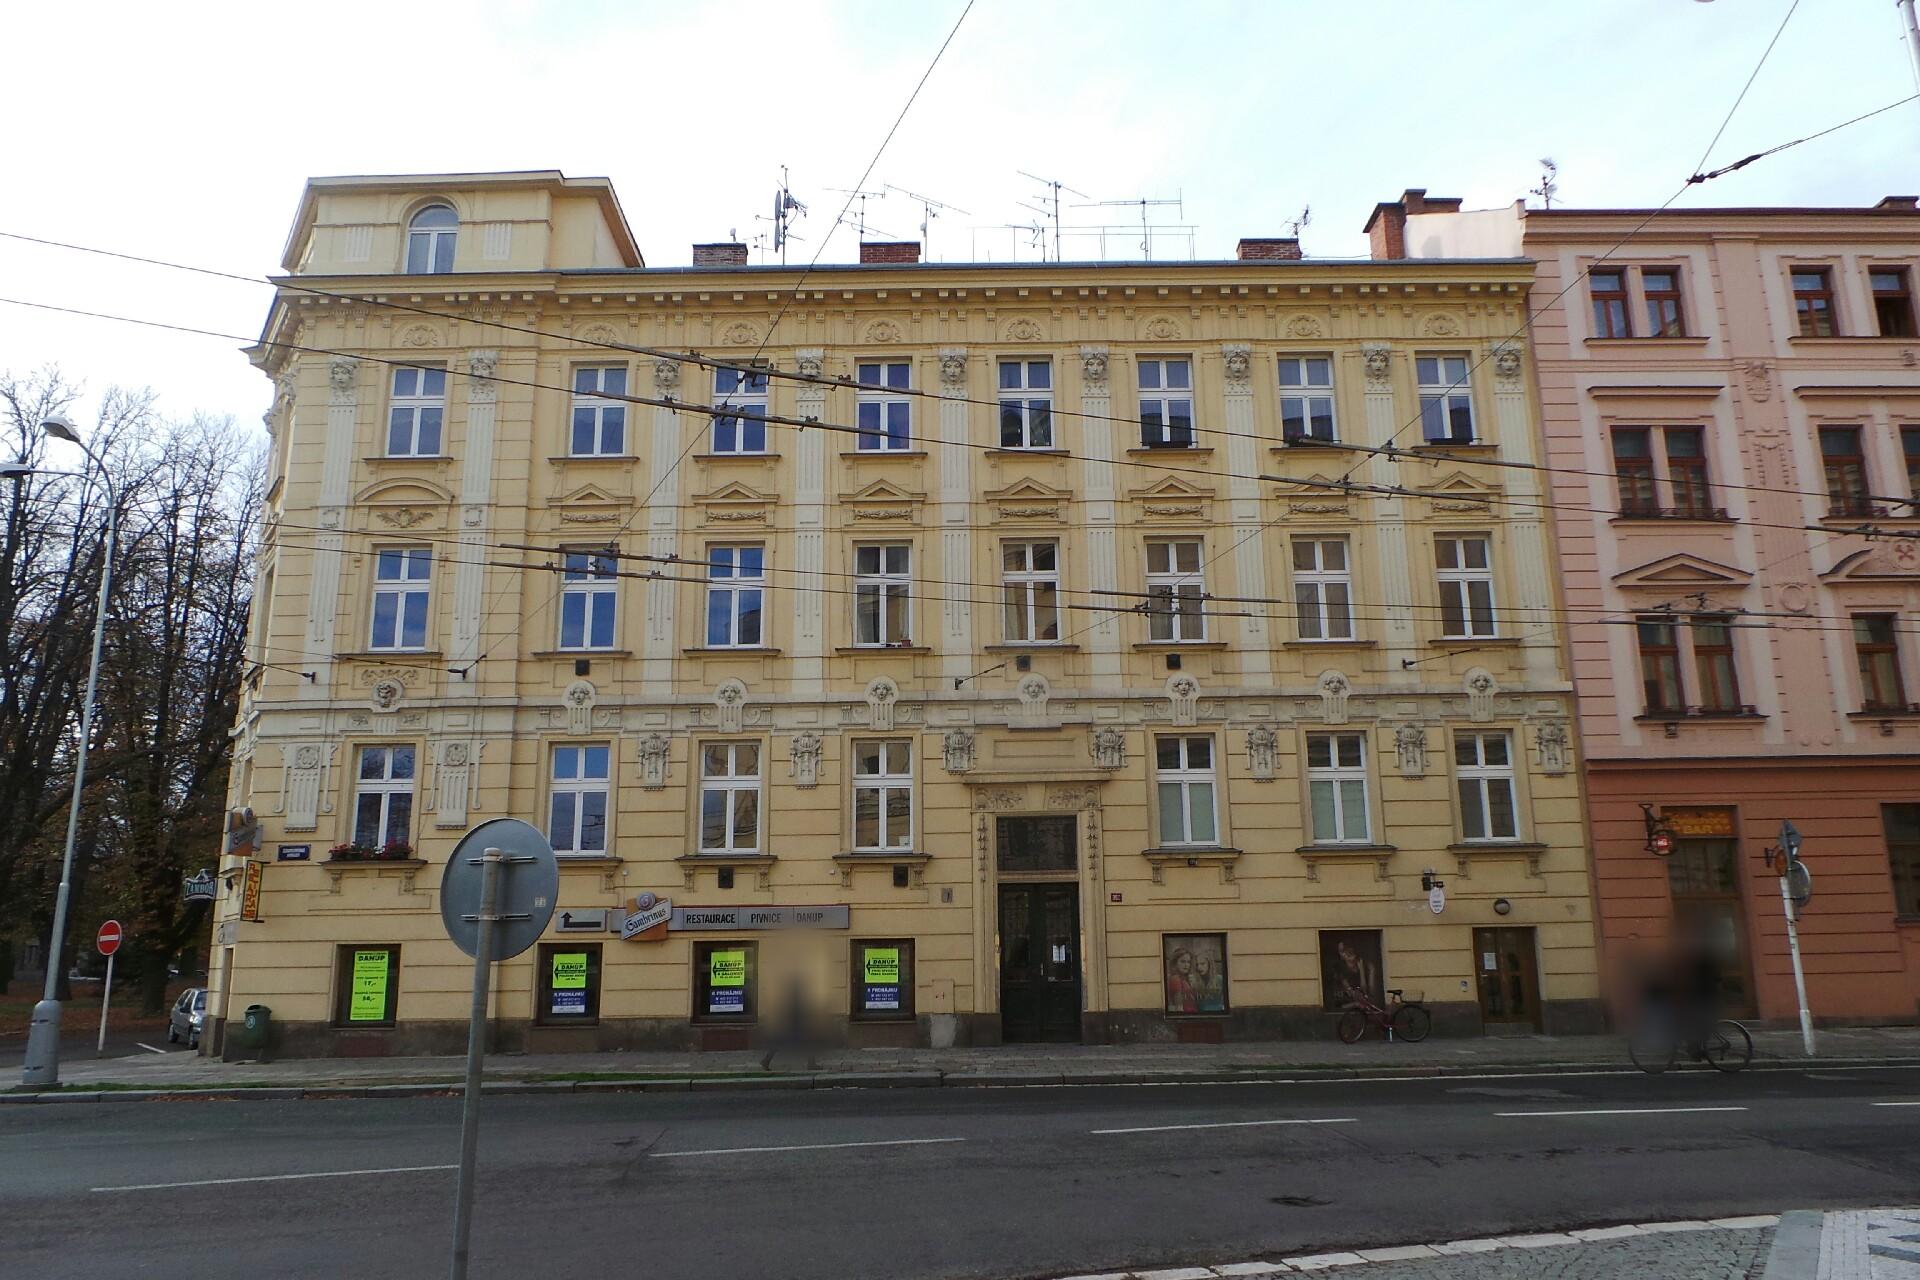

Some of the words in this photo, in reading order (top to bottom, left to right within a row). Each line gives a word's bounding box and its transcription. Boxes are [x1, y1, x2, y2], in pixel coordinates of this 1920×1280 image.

[625, 908, 667, 932] Gambrinus
[686, 913, 736, 924] RESTAURACE
[750, 913, 782, 923] PIVNICE
[796, 912, 824, 923] DANUP
